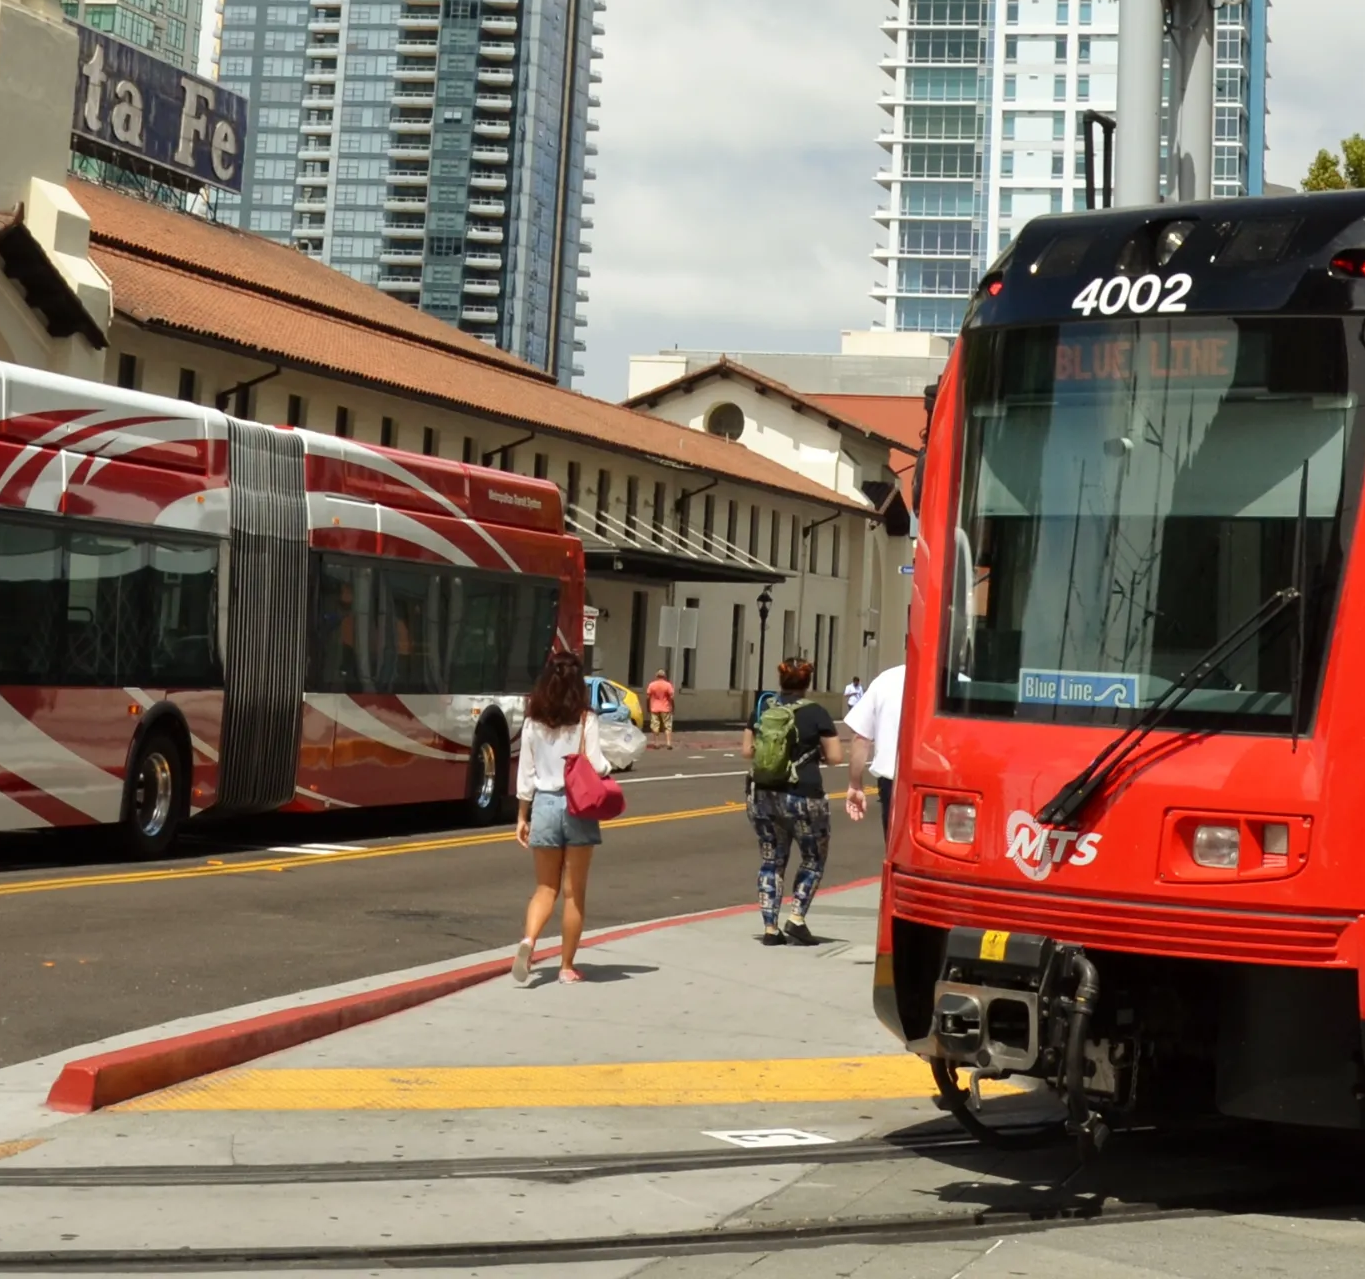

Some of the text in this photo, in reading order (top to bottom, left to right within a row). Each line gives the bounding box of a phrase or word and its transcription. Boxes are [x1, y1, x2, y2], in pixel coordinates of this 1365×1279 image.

[174, 76, 239, 181] Fe
[1071, 273, 1193, 316] 4002
[1055, 338, 1229, 380] BLUE LINE
[1025, 677, 1093, 701] Blue Line
[1005, 827, 1103, 866] MTS
